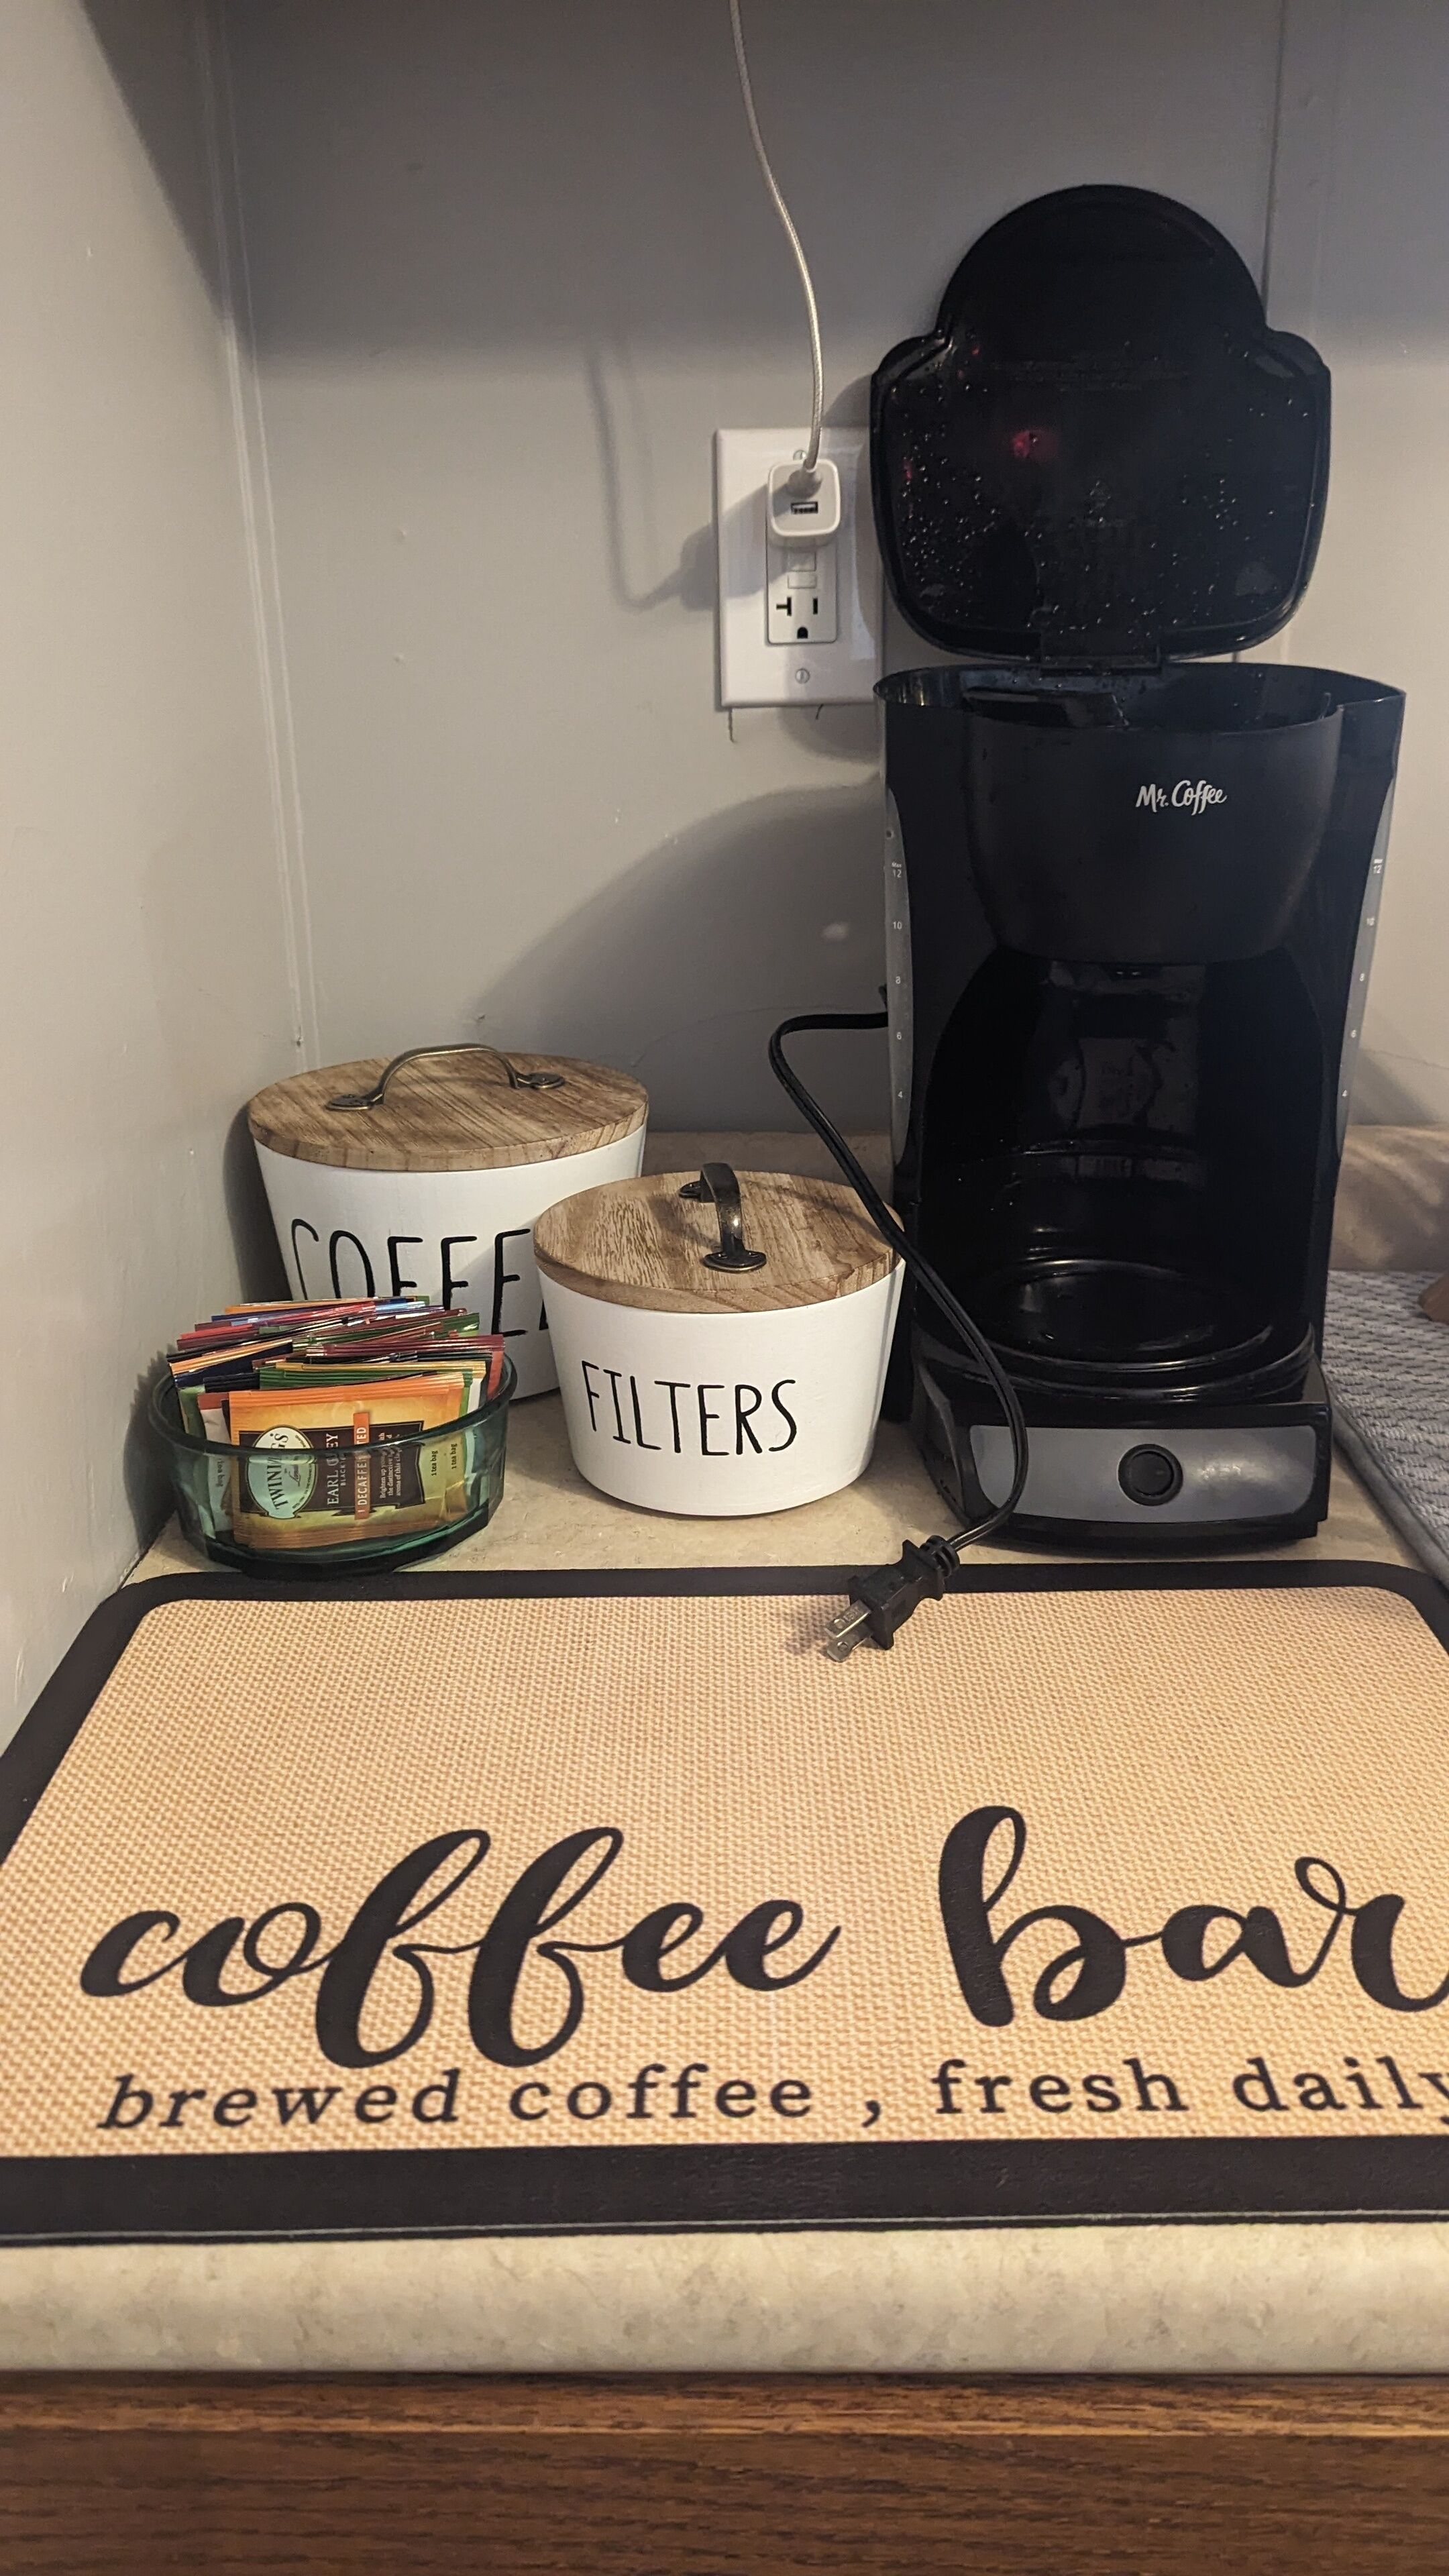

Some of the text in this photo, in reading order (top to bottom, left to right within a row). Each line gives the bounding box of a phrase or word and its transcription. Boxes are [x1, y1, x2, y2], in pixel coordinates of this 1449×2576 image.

[1136, 780, 1228, 816] Mr. Coffee
[892, 869, 902, 878] 12
[892, 921, 902, 930] 10
[896, 976, 901, 985] 8
[896, 1031, 902, 1040] 6
[291, 1218, 549, 1337] COFFE
[582, 1360, 797, 1456] FILTERS
[430, 1450, 438, 1462] bag
[450, 1443, 458, 1455] bag
[325, 1433, 339, 1505] EARL GEY
[356, 1427, 368, 1505] DECAFFEITED
[379, 1477, 387, 1499] Brighten
[79, 1805, 1449, 2068] coffee bar
[97, 2069, 460, 2129] brewed
[510, 2063, 812, 2121] coffee
[932, 2058, 1189, 2114] fresh
